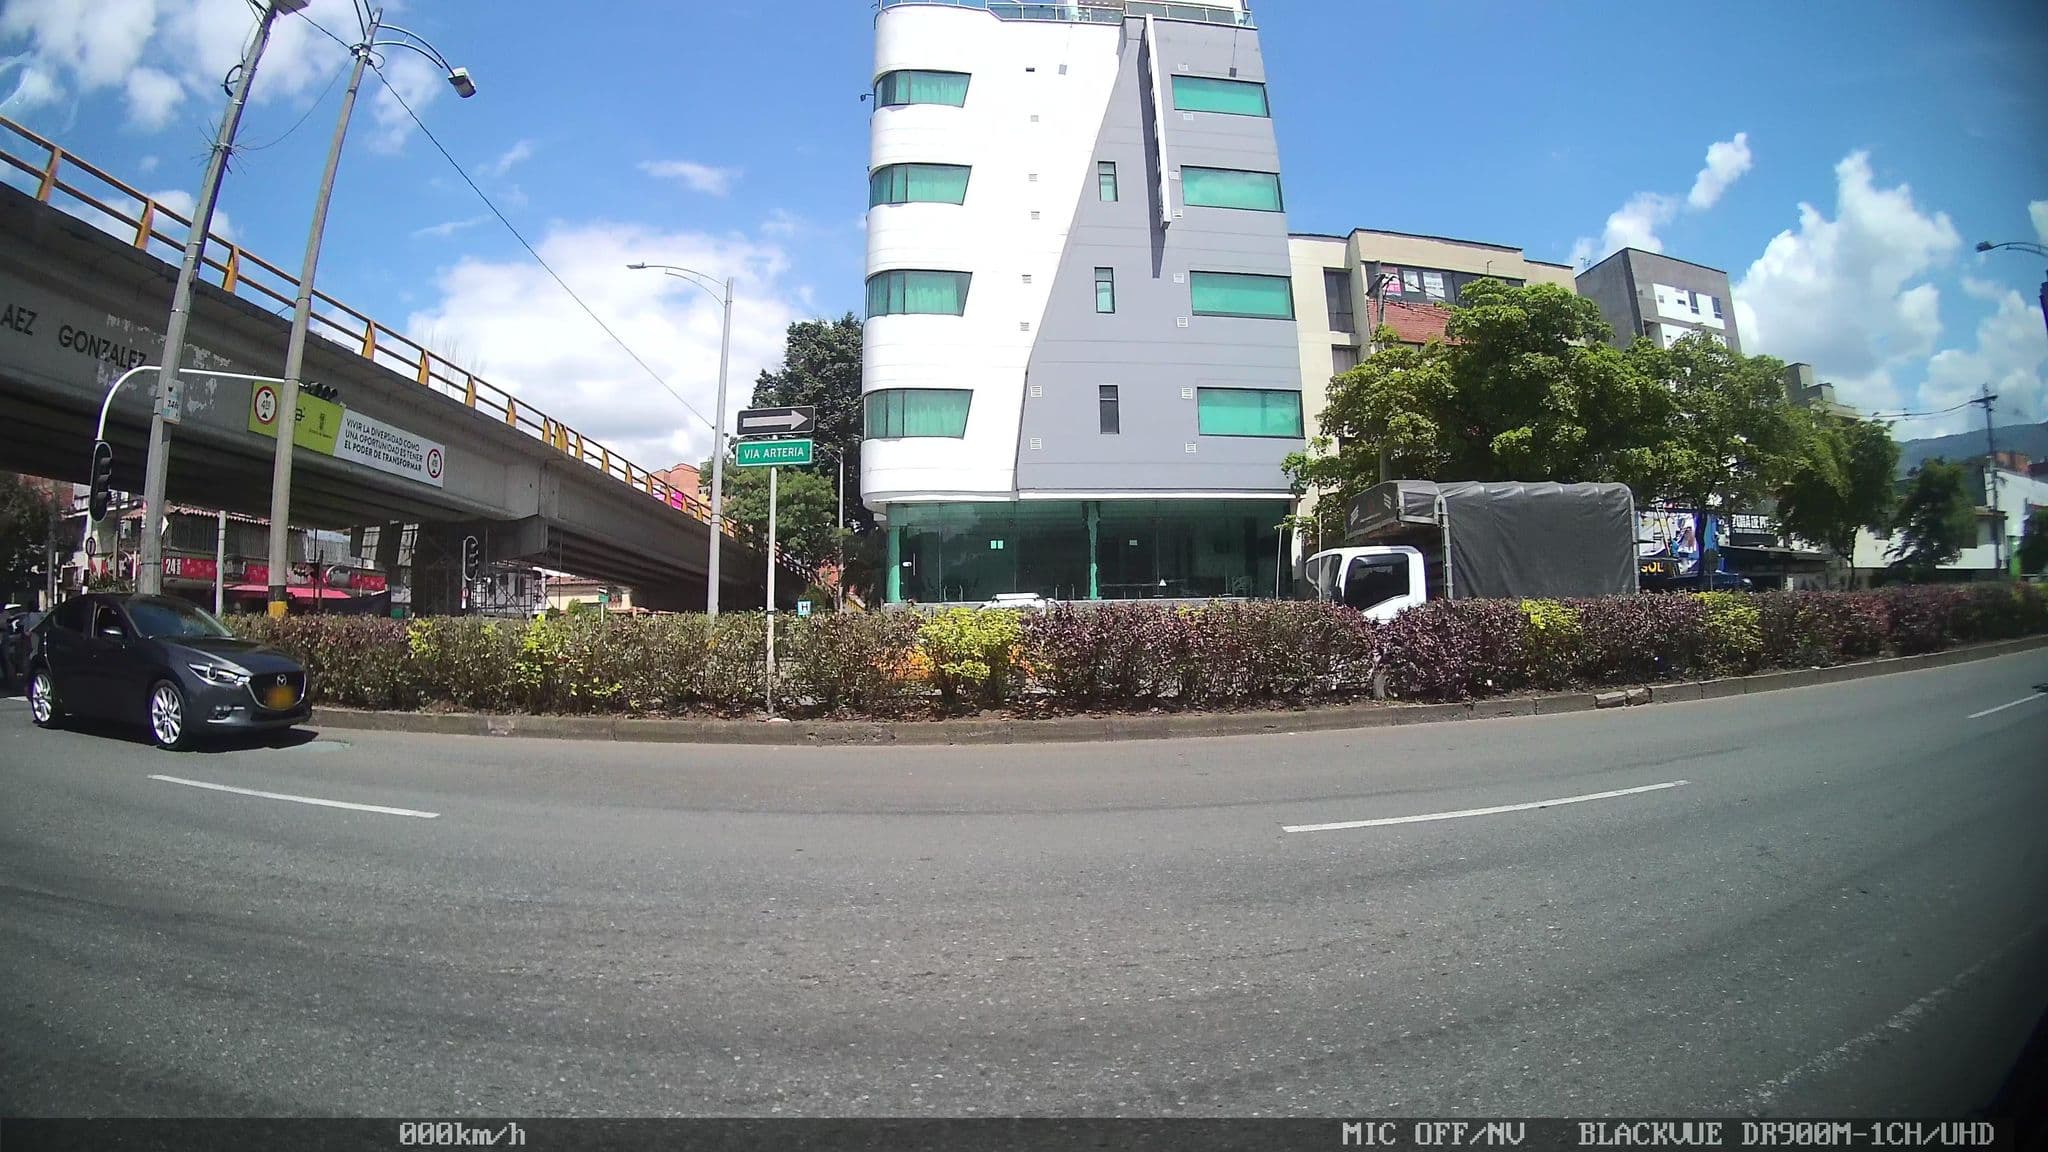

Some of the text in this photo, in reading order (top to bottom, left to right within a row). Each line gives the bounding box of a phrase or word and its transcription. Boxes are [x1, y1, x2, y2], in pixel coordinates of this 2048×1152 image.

[345, 430, 358, 441] UNA
[360, 434, 400, 455] OPORTUNIDAD
[400, 448, 406, 458] ES
[406, 449, 423, 463] TENER
[346, 418, 420, 451] VIVIR LA DIVERSIDAD COMO
[344, 440, 351, 450] EL
[353, 443, 373, 458] PODER
[374, 450, 381, 460] DE
[382, 453, 422, 472] TRANSFORMAR
[744, 446, 804, 459] VIA ARTERIA
[166, 559, 176, 575] 24
[801, 603, 808, 611] H
